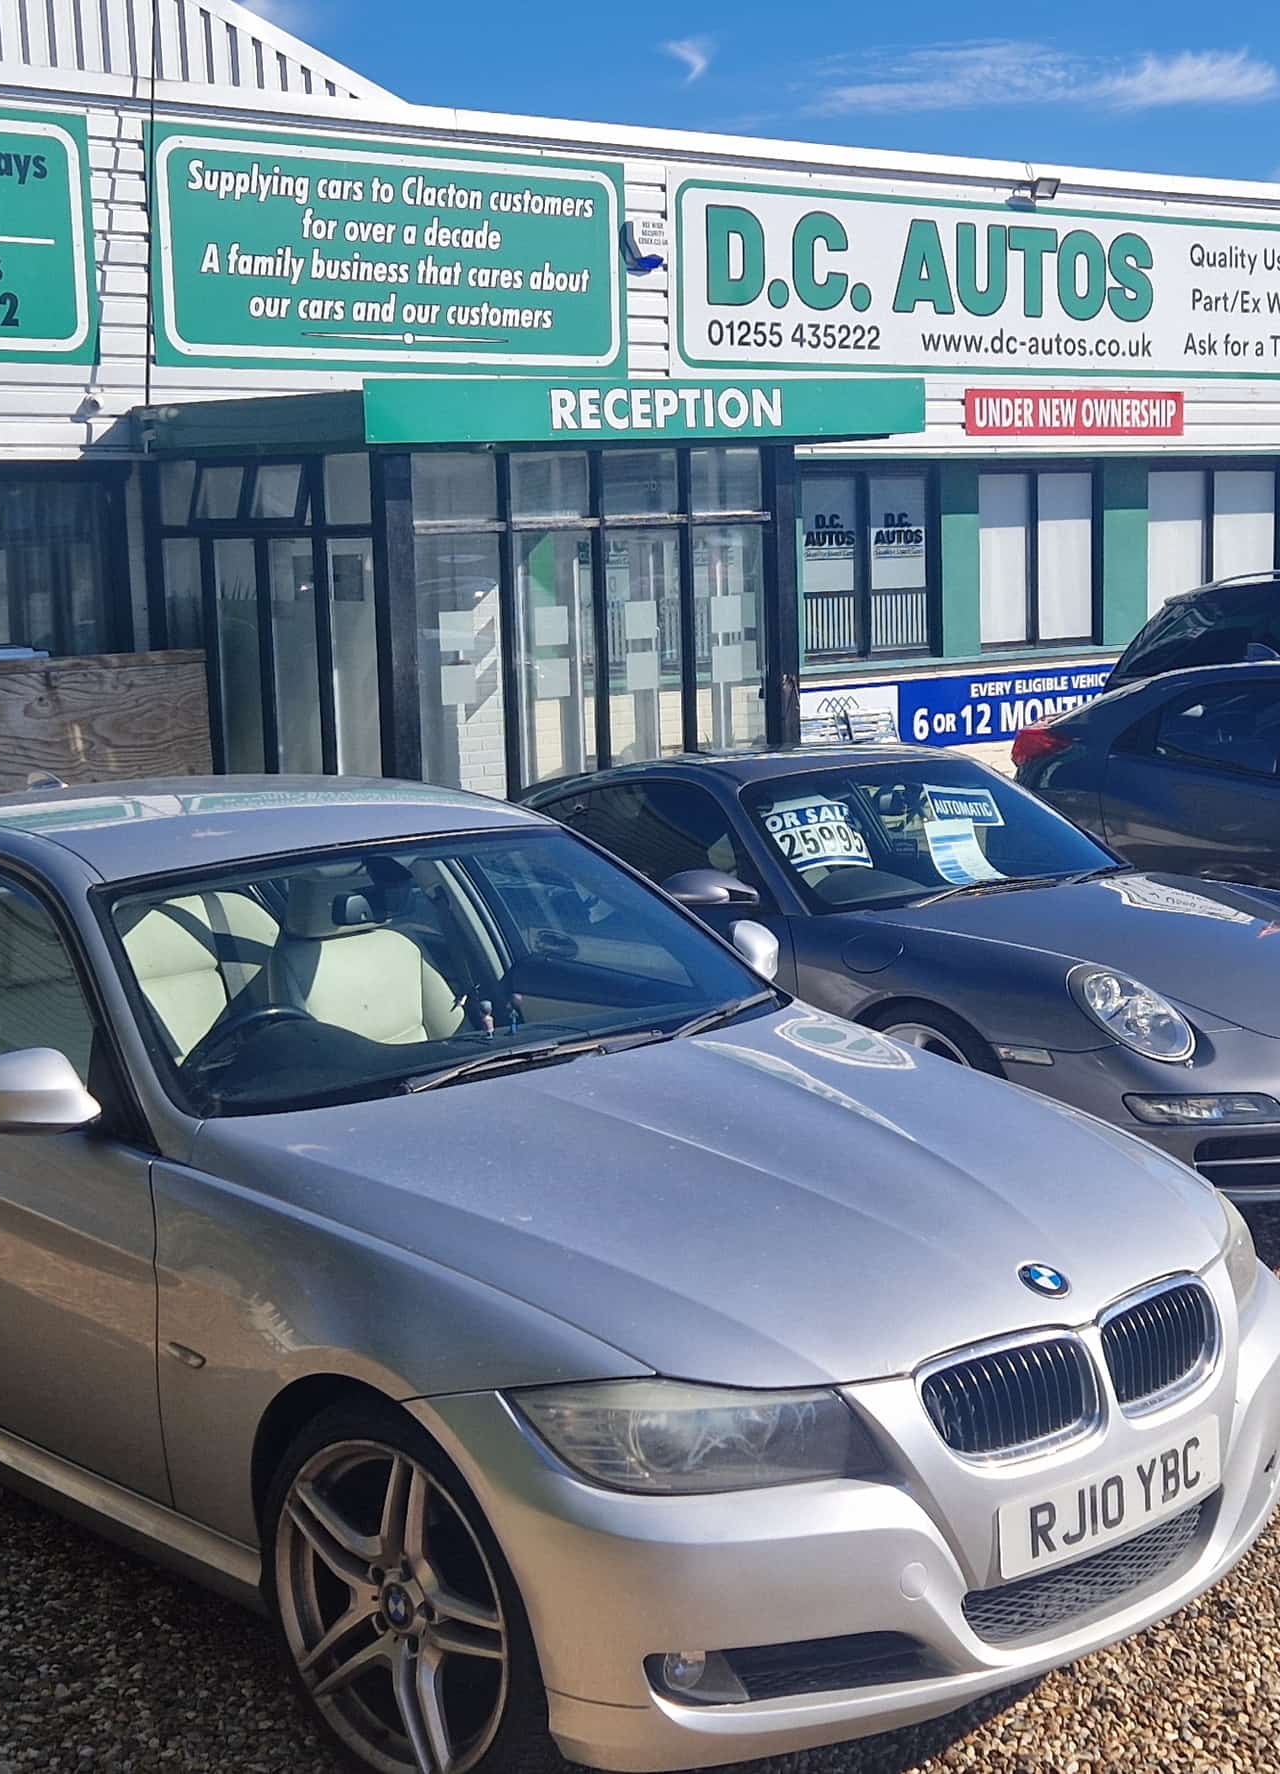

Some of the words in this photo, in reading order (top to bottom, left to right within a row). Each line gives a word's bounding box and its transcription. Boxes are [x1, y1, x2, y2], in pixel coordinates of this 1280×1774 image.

[187, 159, 308, 204] Supplying
[317, 177, 364, 202] cars
[371, 177, 395, 204] to
[402, 176, 483, 211] Clacton
[489, 188, 594, 218] customers
[301, 208, 338, 241] for
[344, 220, 396, 245] over
[403, 227, 417, 244] a
[424, 216, 502, 251] decade
[201, 243, 220, 273] A
[228, 241, 305, 285] family
[310, 246, 409, 285] business
[417, 255, 461, 288] that
[467, 265, 523, 290] cares
[530, 261, 590, 294] about
[705, 203, 872, 313] D.C.
[892, 217, 1154, 323] AUTOS
[1189, 244, 1257, 277] Quality
[248, 295, 289, 319] our
[298, 299, 345, 321] cars
[353, 293, 396, 324] and
[402, 302, 440, 325] our
[446, 302, 552, 330] customers
[1190, 289, 1262, 317] Part/Ex
[707, 319, 783, 350] 01255
[790, 323, 881, 351] 435222
[921, 329, 1153, 359] www.dc-autos.co.uk
[1182, 333, 1217, 359] Ask
[1221, 333, 1248, 359] for
[1253, 339, 1264, 359] a
[550, 387, 784, 430] RECEPTION
[974, 398, 1033, 430] UNDER
[1038, 398, 1077, 428] NEW
[1081, 396, 1177, 428] OWNERSHIP
[815, 514, 844, 529] D.C.
[883, 512, 912, 528] D.C.
[805, 530, 855, 547] AUTOS
[874, 529, 923, 545] AUTOS
[971, 680, 1012, 698] EVERY
[1015, 676, 1068, 694] ELIGIBLE
[1071, 672, 1111, 690] VEHIC
[913, 707, 930, 740] 6
[933, 716, 957, 734] OR
[960, 703, 993, 737] 12
[1000, 692, 1104, 733] MONT
[765, 811, 803, 833] OR
[933, 798, 993, 817] AUTOMATIC
[1029, 1474, 1125, 1560] RJ10
[1135, 1436, 1201, 1512] YBC
